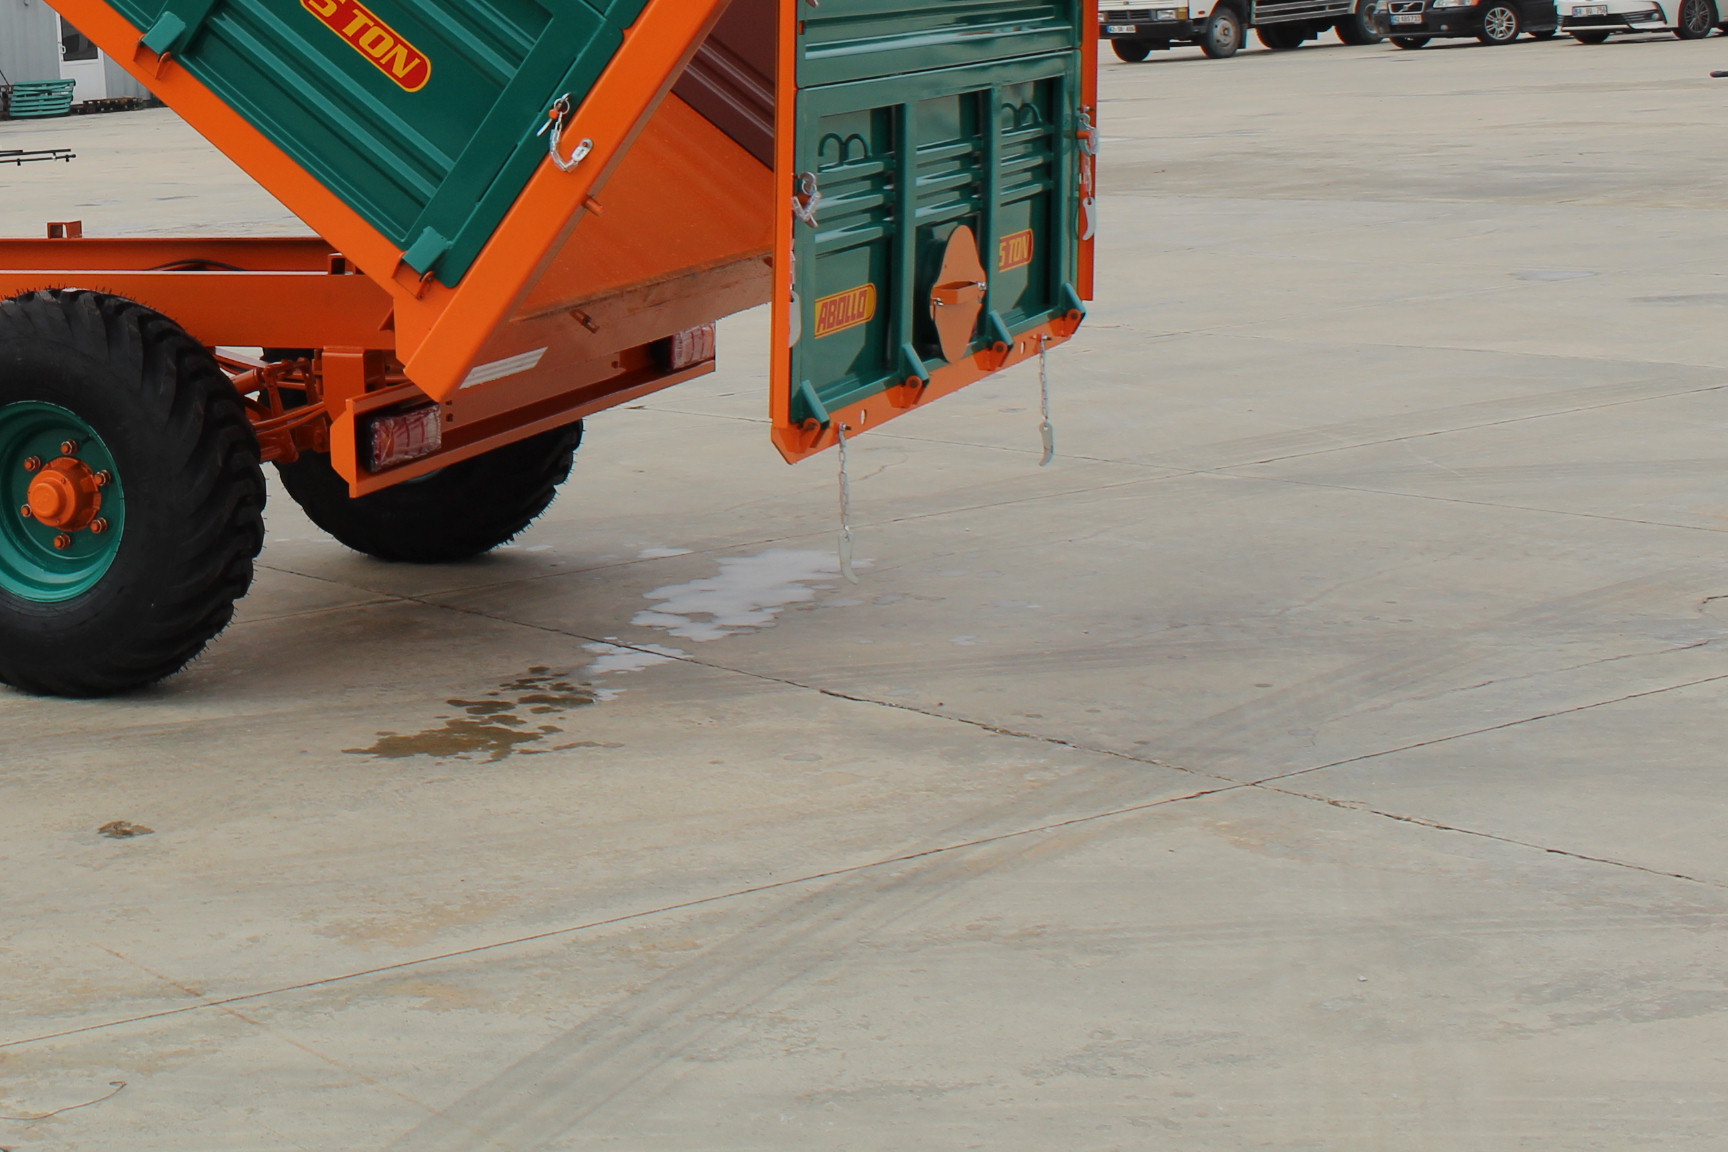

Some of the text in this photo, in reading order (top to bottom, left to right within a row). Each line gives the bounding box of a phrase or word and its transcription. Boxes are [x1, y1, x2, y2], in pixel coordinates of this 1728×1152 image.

[342, 8, 421, 79] TON
[998, 234, 1031, 267] 5 TON
[816, 289, 868, 333] ABOLLO
